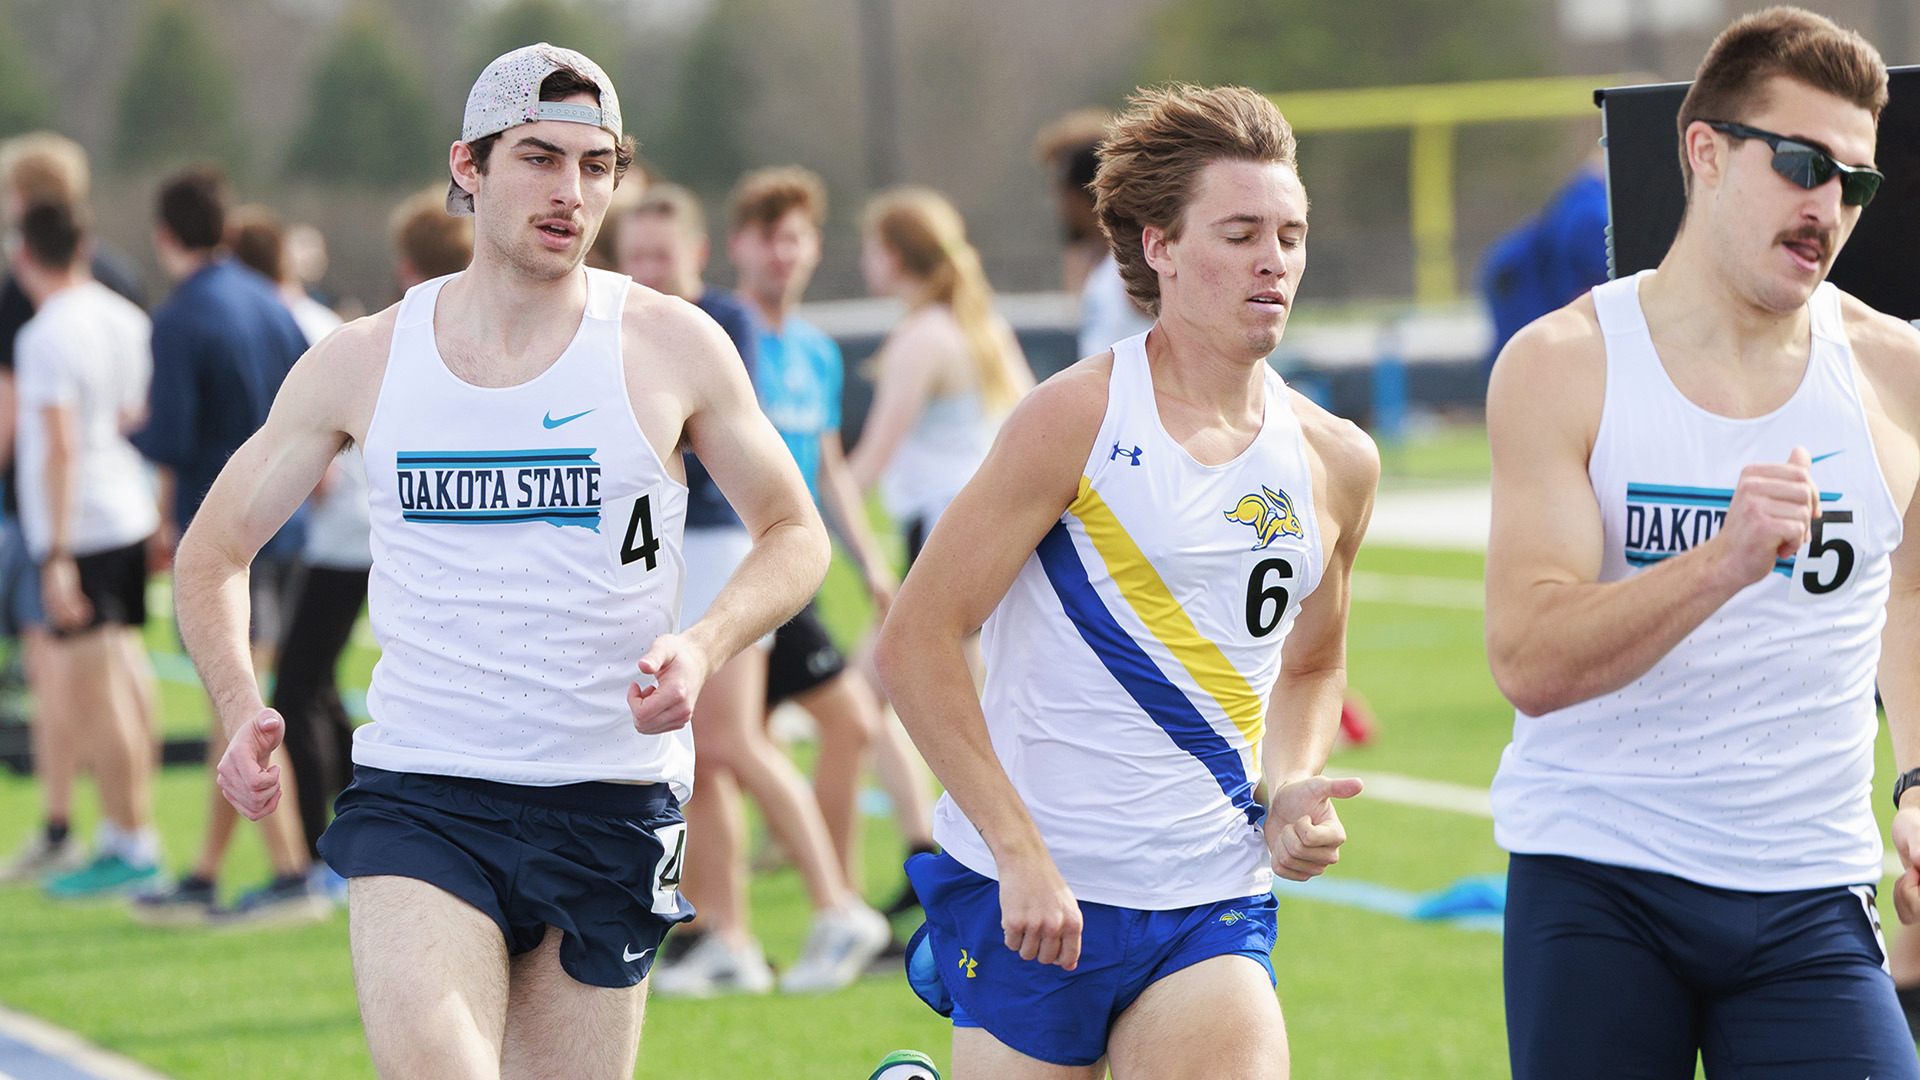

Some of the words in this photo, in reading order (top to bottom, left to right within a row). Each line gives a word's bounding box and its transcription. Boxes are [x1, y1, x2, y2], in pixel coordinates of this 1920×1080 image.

[398, 470, 509, 510] DAKOTA
[516, 467, 601, 508] STATE
[620, 493, 660, 572] 4
[1802, 510, 1855, 595] 5
[1245, 557, 1294, 638] 6
[658, 829, 686, 891] 4
